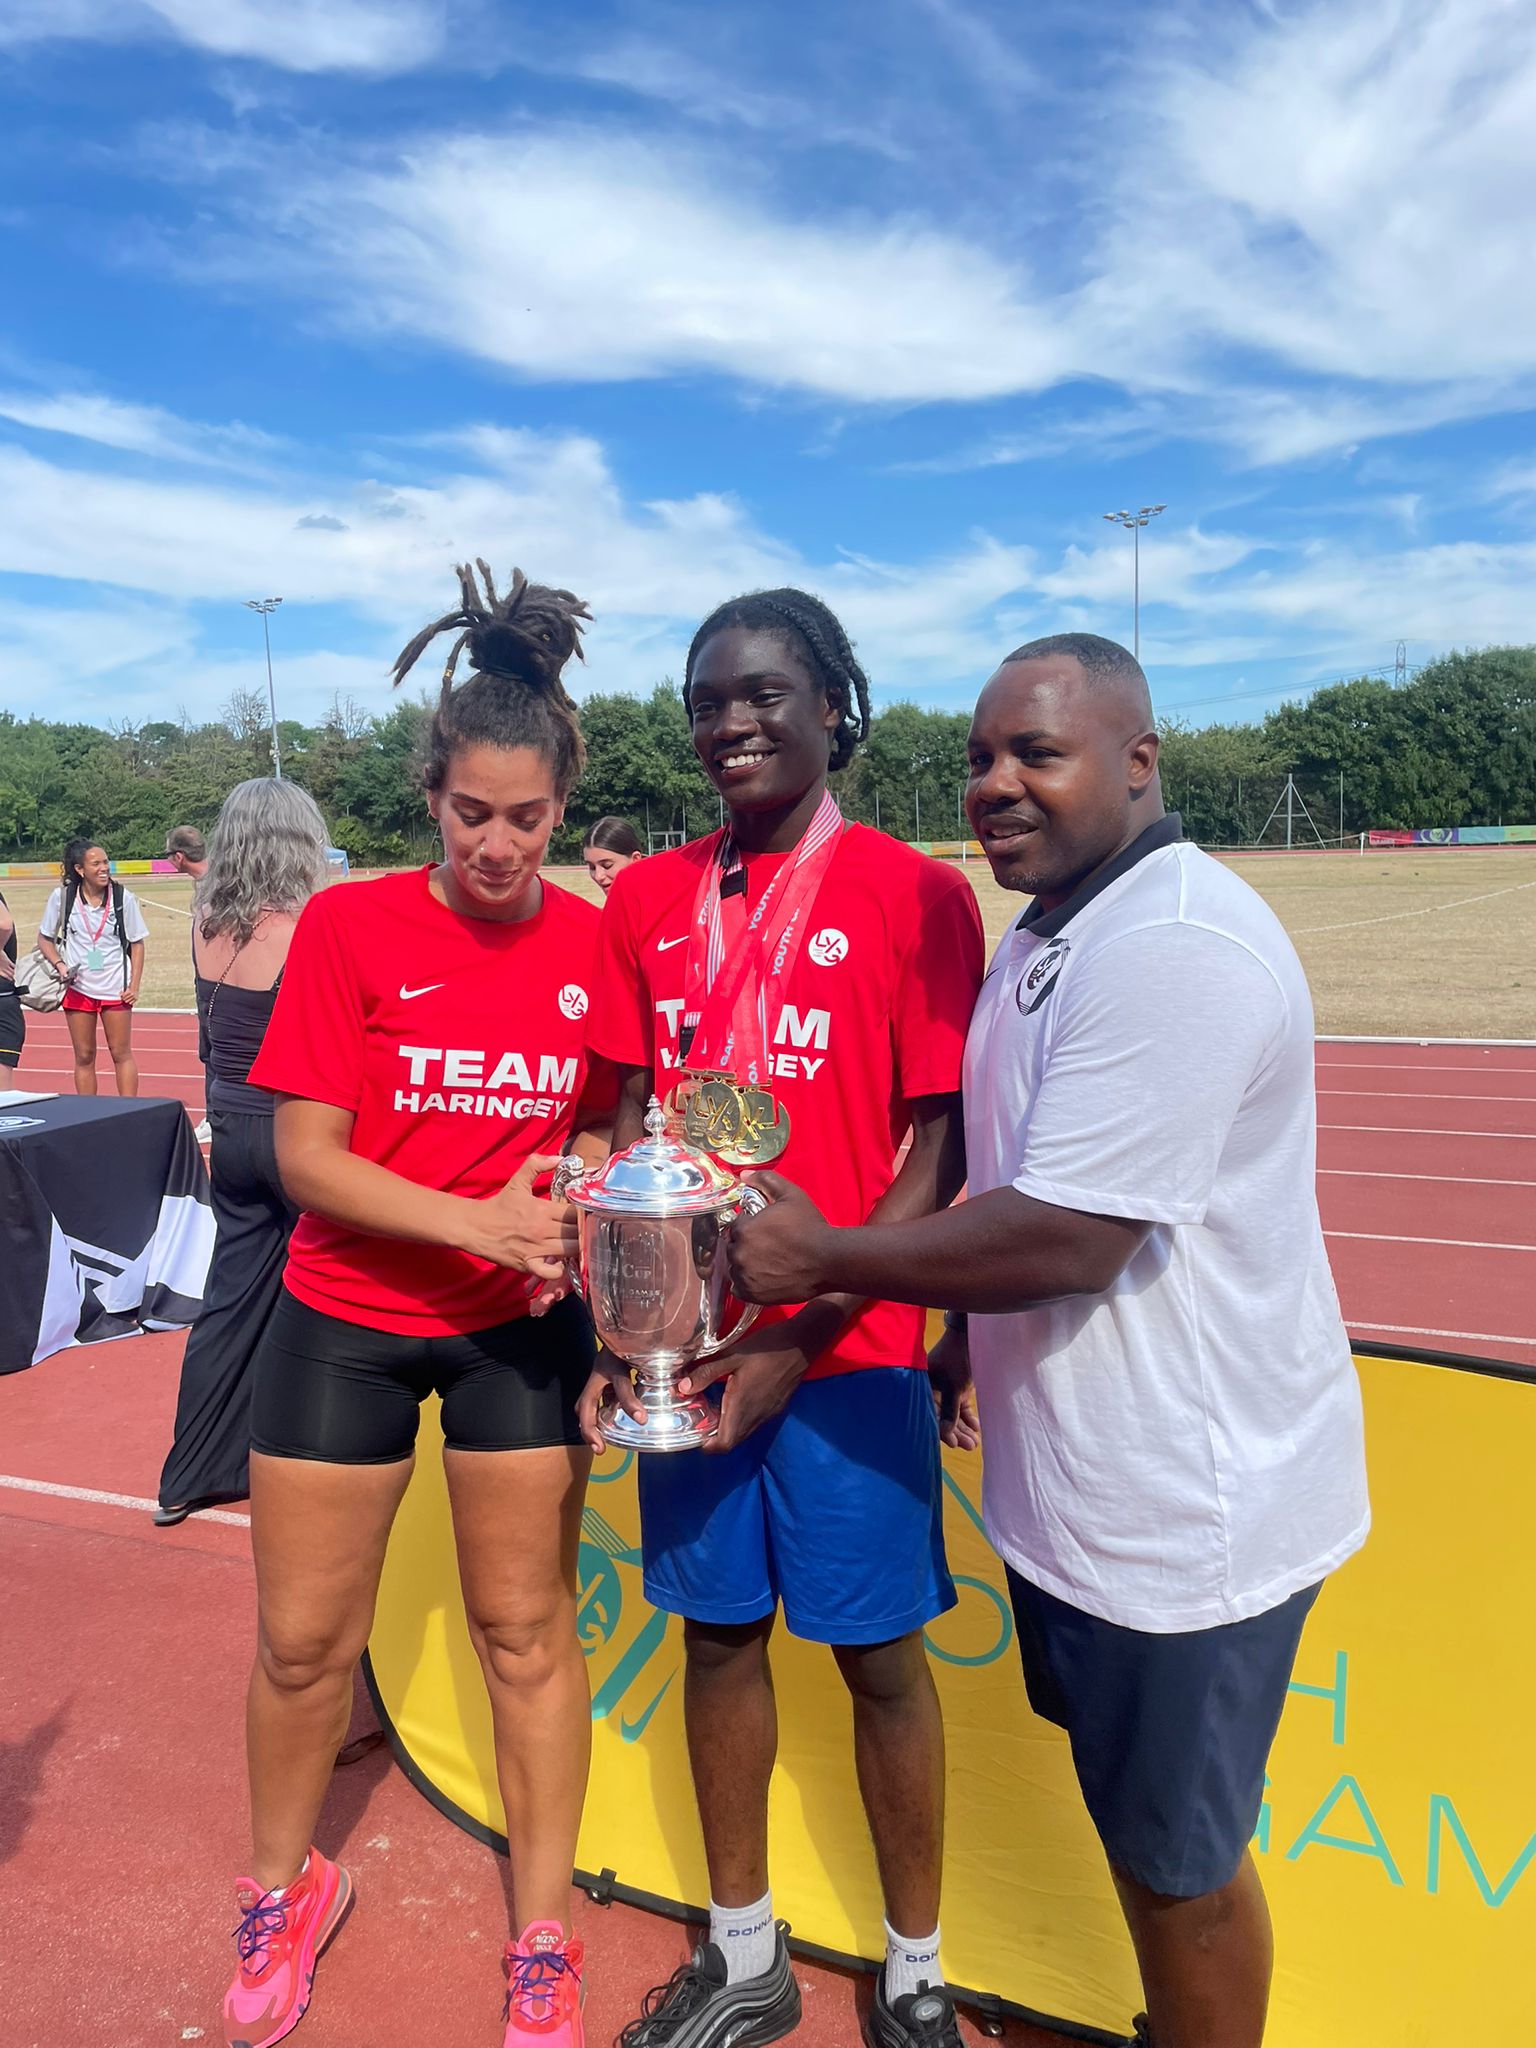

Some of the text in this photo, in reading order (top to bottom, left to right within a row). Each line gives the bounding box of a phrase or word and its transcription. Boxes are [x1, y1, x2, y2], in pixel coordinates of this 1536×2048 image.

[772, 925, 795, 976] YOUTH
[656, 999, 831, 1050] TM
[399, 1045, 578, 1094] TEAM
[394, 1090, 568, 1120] HARINGEY
